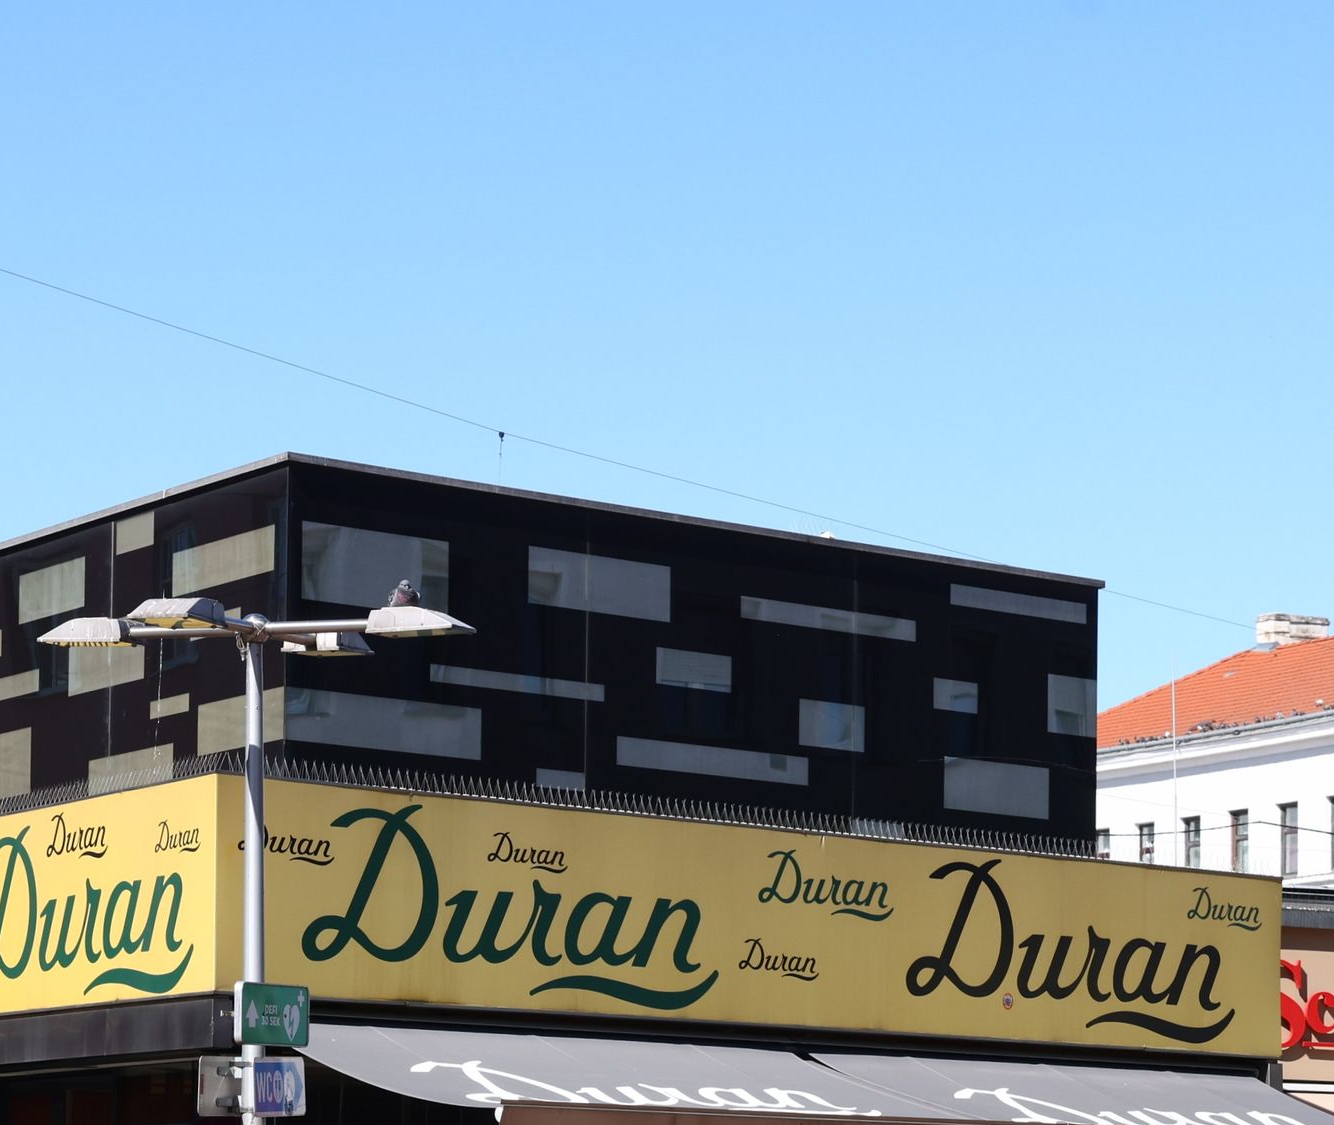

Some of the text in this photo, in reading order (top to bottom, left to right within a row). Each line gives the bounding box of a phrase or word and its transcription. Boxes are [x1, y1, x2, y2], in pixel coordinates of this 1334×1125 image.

[46, 814, 108, 859] Duran
[154, 818, 201, 853] Duran
[487, 832, 567, 873] Duran
[301, 804, 718, 1010] Duran
[757, 850, 894, 921] Duran
[1187, 887, 1262, 932] Duran
[739, 938, 820, 982] Duran
[906, 859, 1235, 1044] Duran
[262, 1016, 281, 1027] 30 SEK
[265, 1004, 278, 1015] DEFI
[256, 1071, 273, 1104] WC
[410, 1059, 882, 1121] Duran
